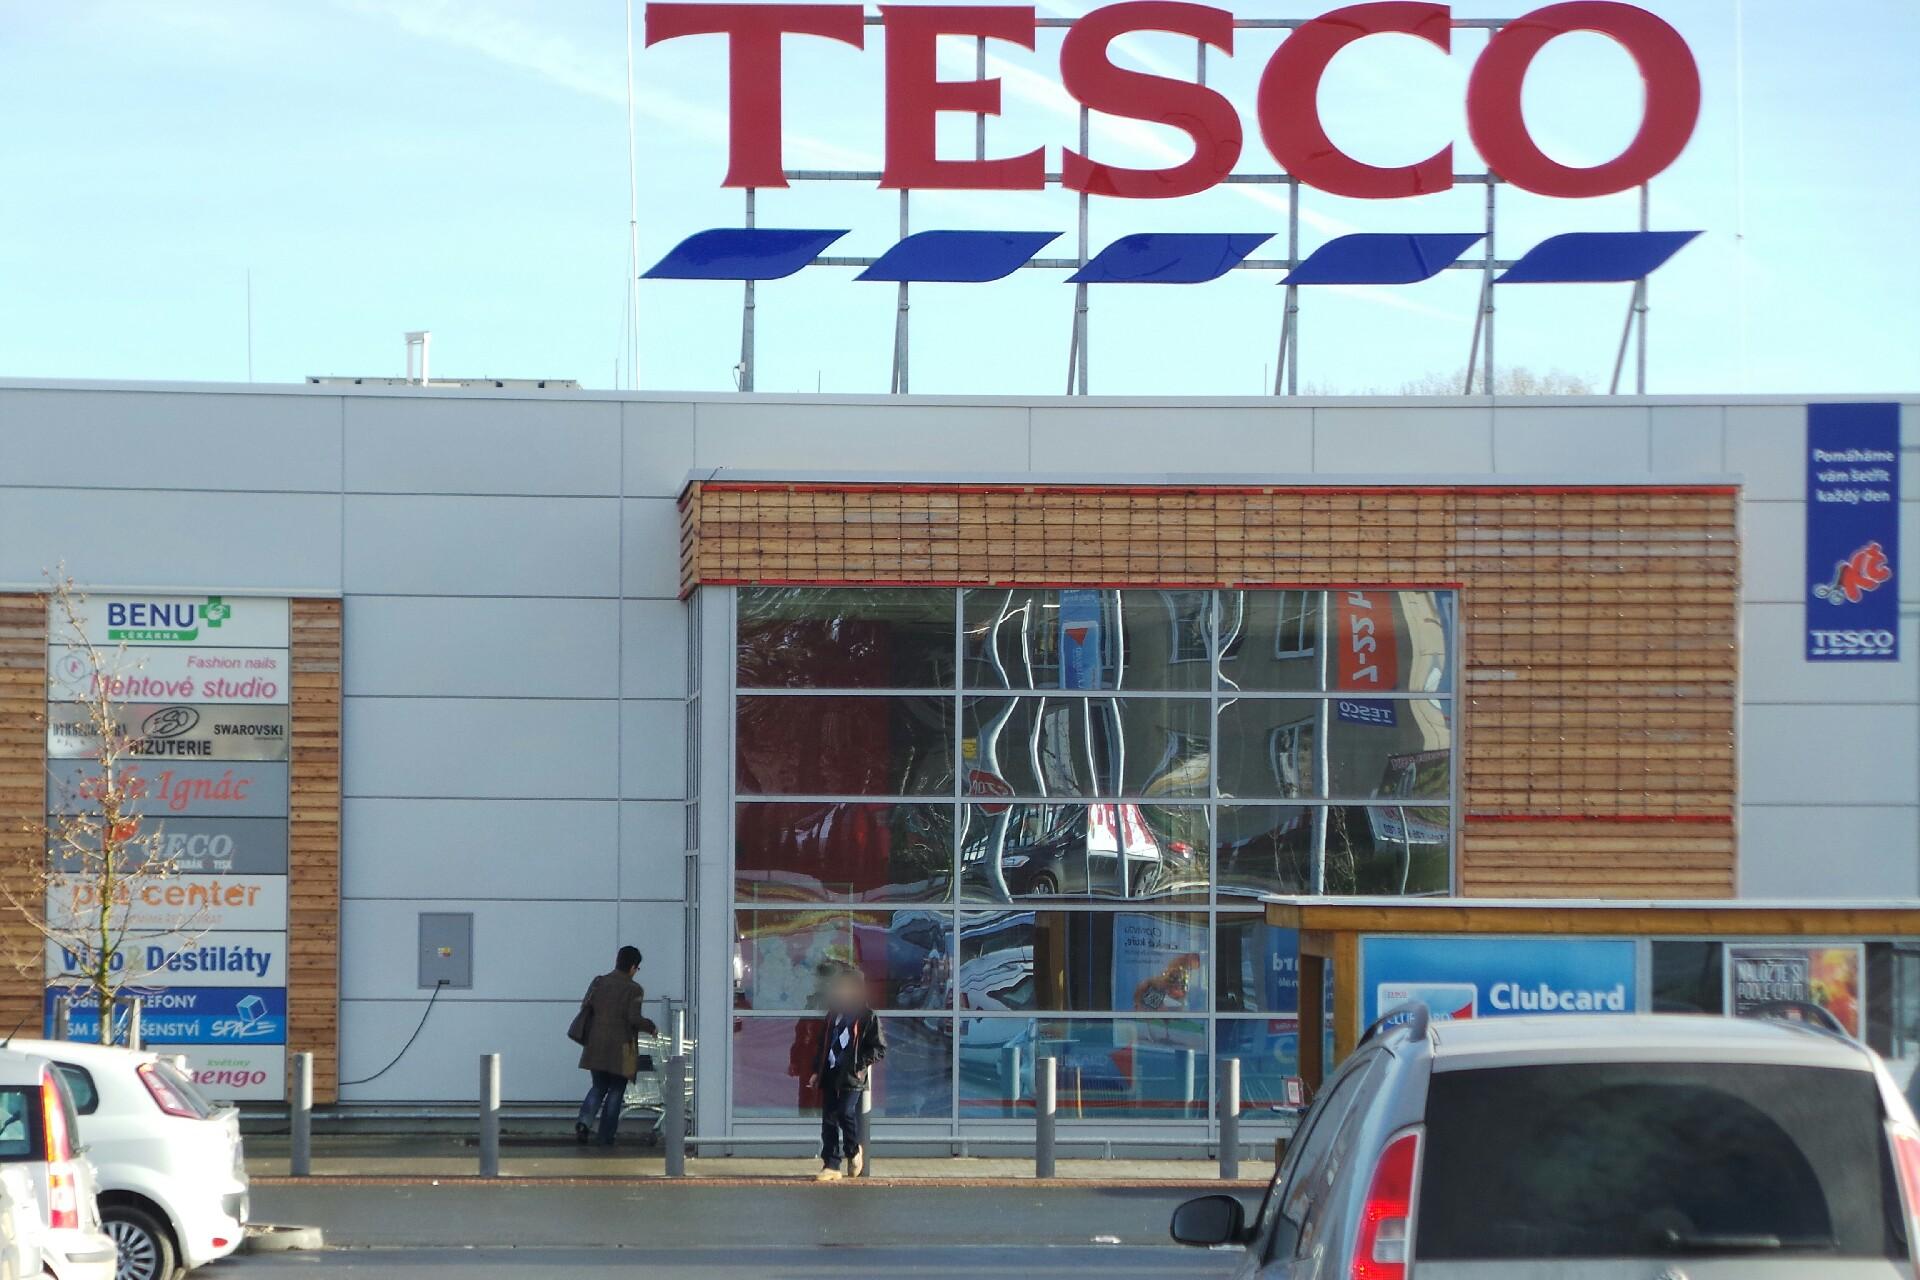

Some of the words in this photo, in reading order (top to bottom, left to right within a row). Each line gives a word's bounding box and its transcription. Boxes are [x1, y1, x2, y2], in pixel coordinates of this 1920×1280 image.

[645, 0, 1702, 200] TESCO
[1862, 488, 1890, 502] den
[107, 603, 194, 628] BENU
[1811, 630, 1895, 648] TESCO
[186, 656, 240, 670] Fashion
[244, 656, 277, 670] nails
[202, 676, 278, 698] studio
[213, 723, 284, 736] SWAROVSKI
[155, 769, 252, 811] Ignác
[141, 881, 261, 906] center
[146, 946, 271, 977] Destiláty
[1489, 982, 1626, 1011] Clubcard
